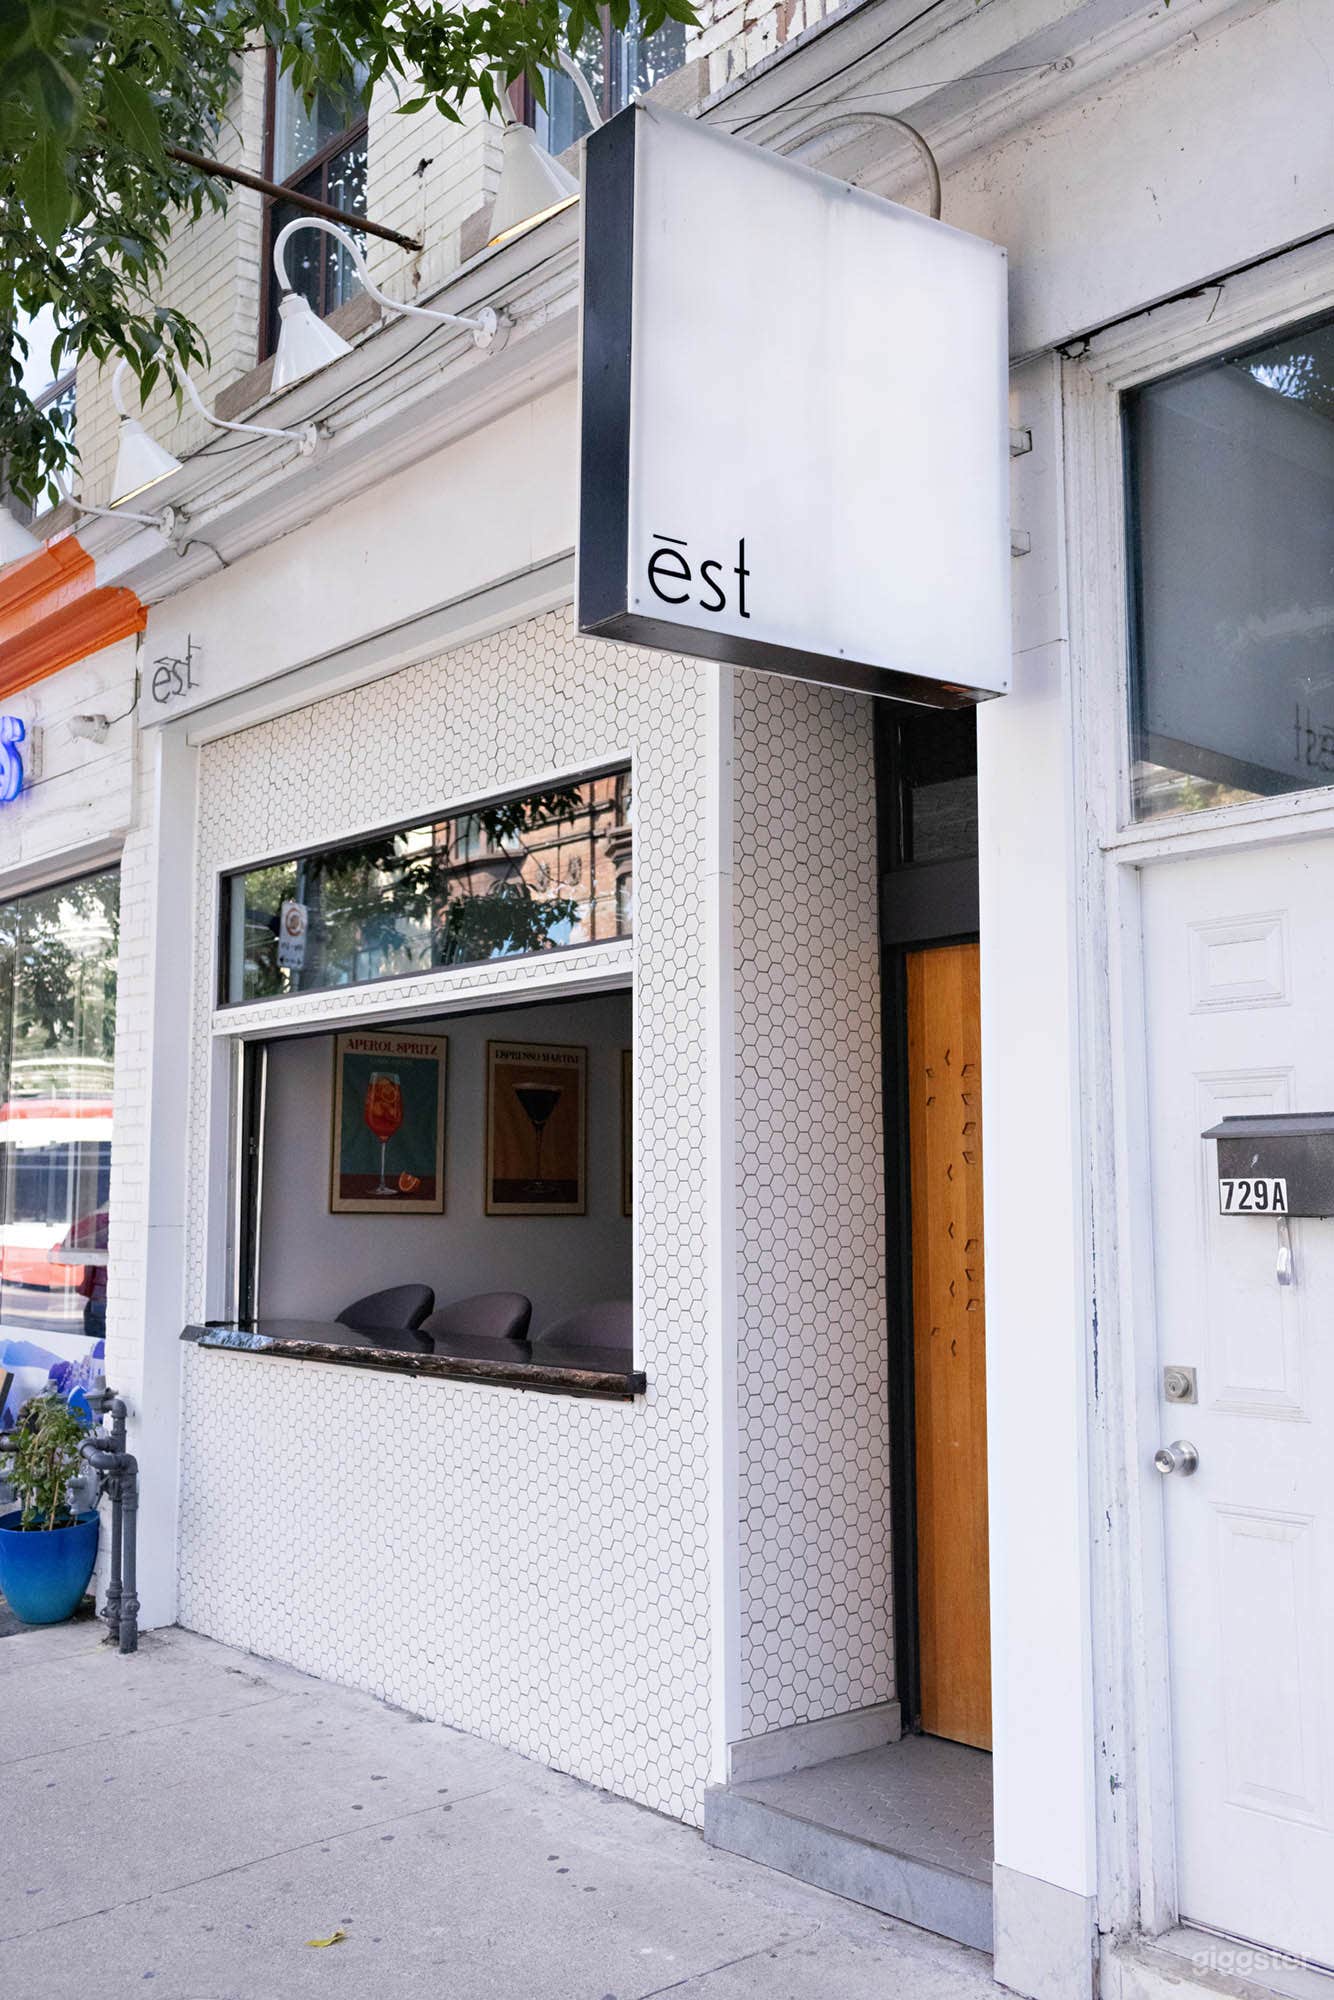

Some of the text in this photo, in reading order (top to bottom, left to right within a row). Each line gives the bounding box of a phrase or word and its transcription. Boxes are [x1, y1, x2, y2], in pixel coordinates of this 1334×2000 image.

[647, 533, 751, 619] ēst
[346, 1038, 439, 1056] APEROL SPRITZ
[1222, 1180, 1286, 1211] 729A
